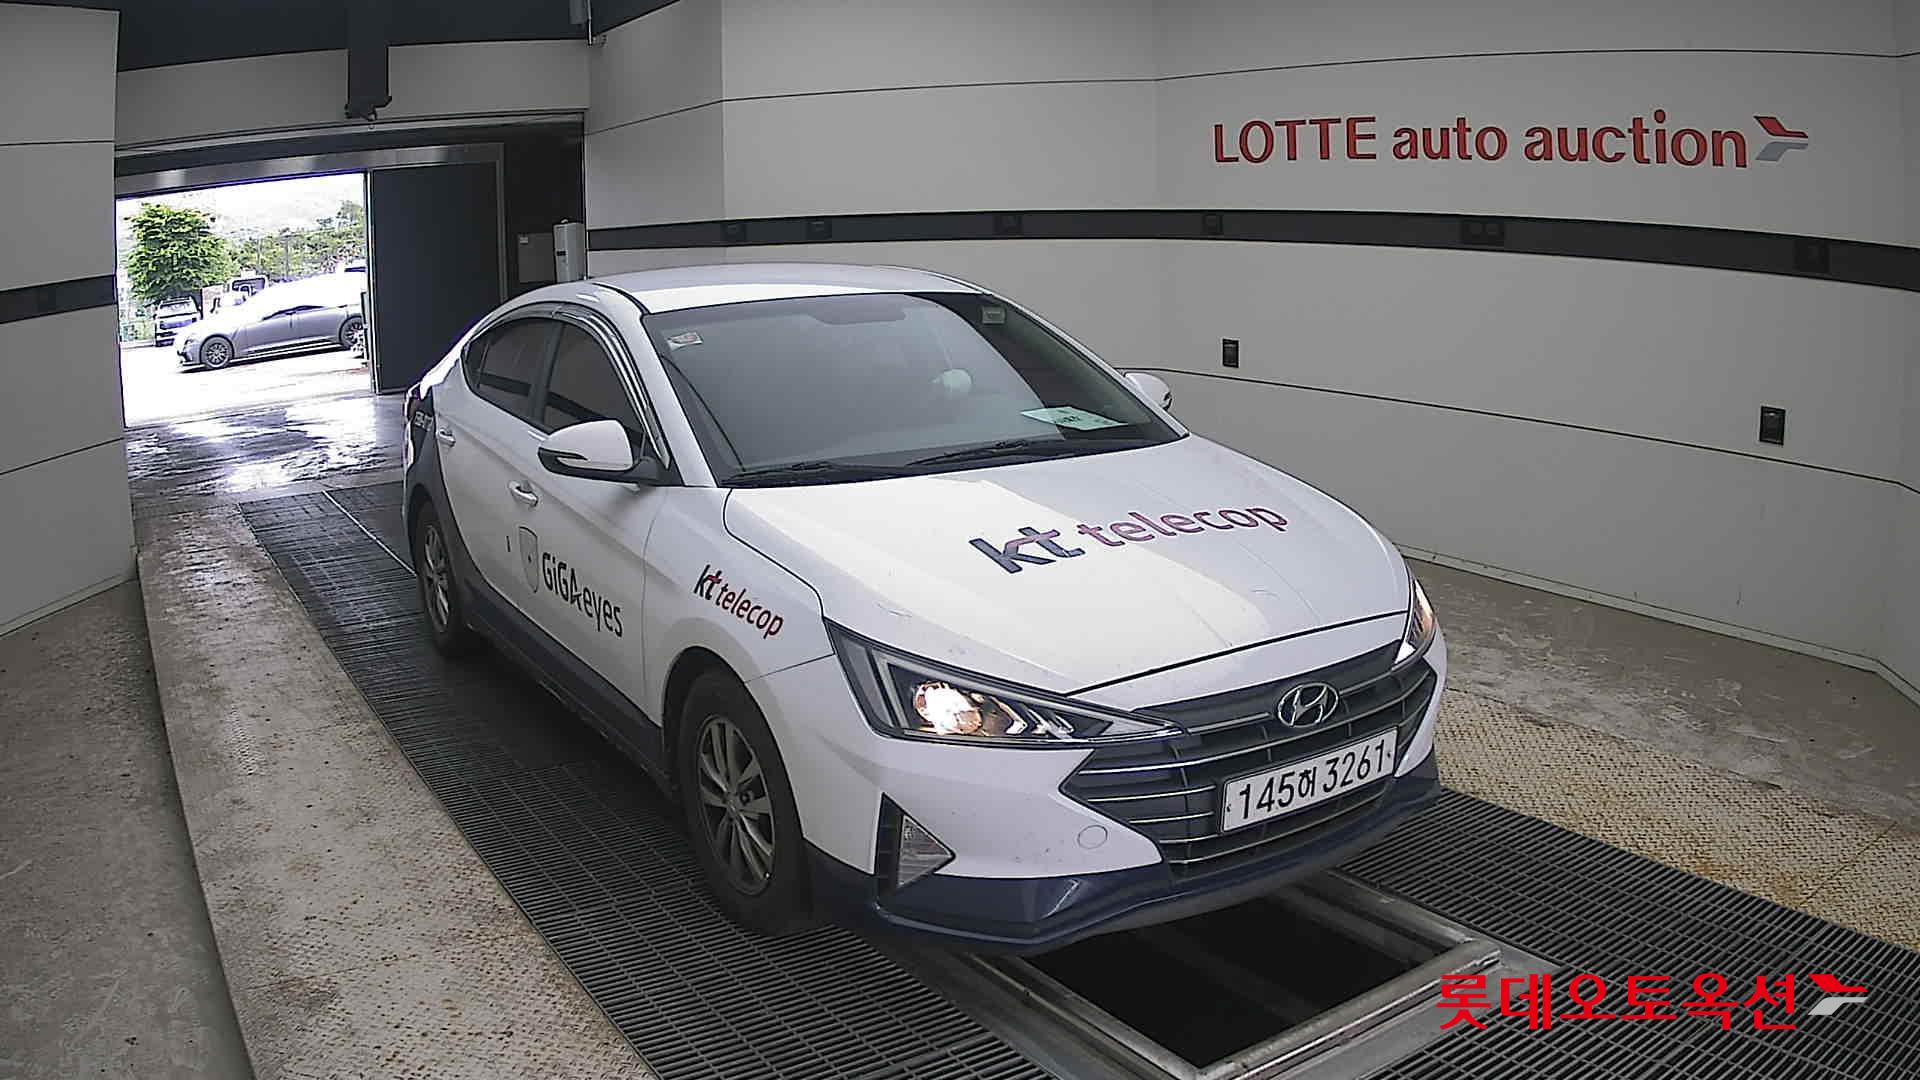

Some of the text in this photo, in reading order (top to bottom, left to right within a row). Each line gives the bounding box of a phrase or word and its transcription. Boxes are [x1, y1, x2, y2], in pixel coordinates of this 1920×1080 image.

[1214, 109, 1748, 168] LOTTE auto auction
[968, 507, 1289, 574] kt telecop
[693, 564, 784, 640] kt telecop
